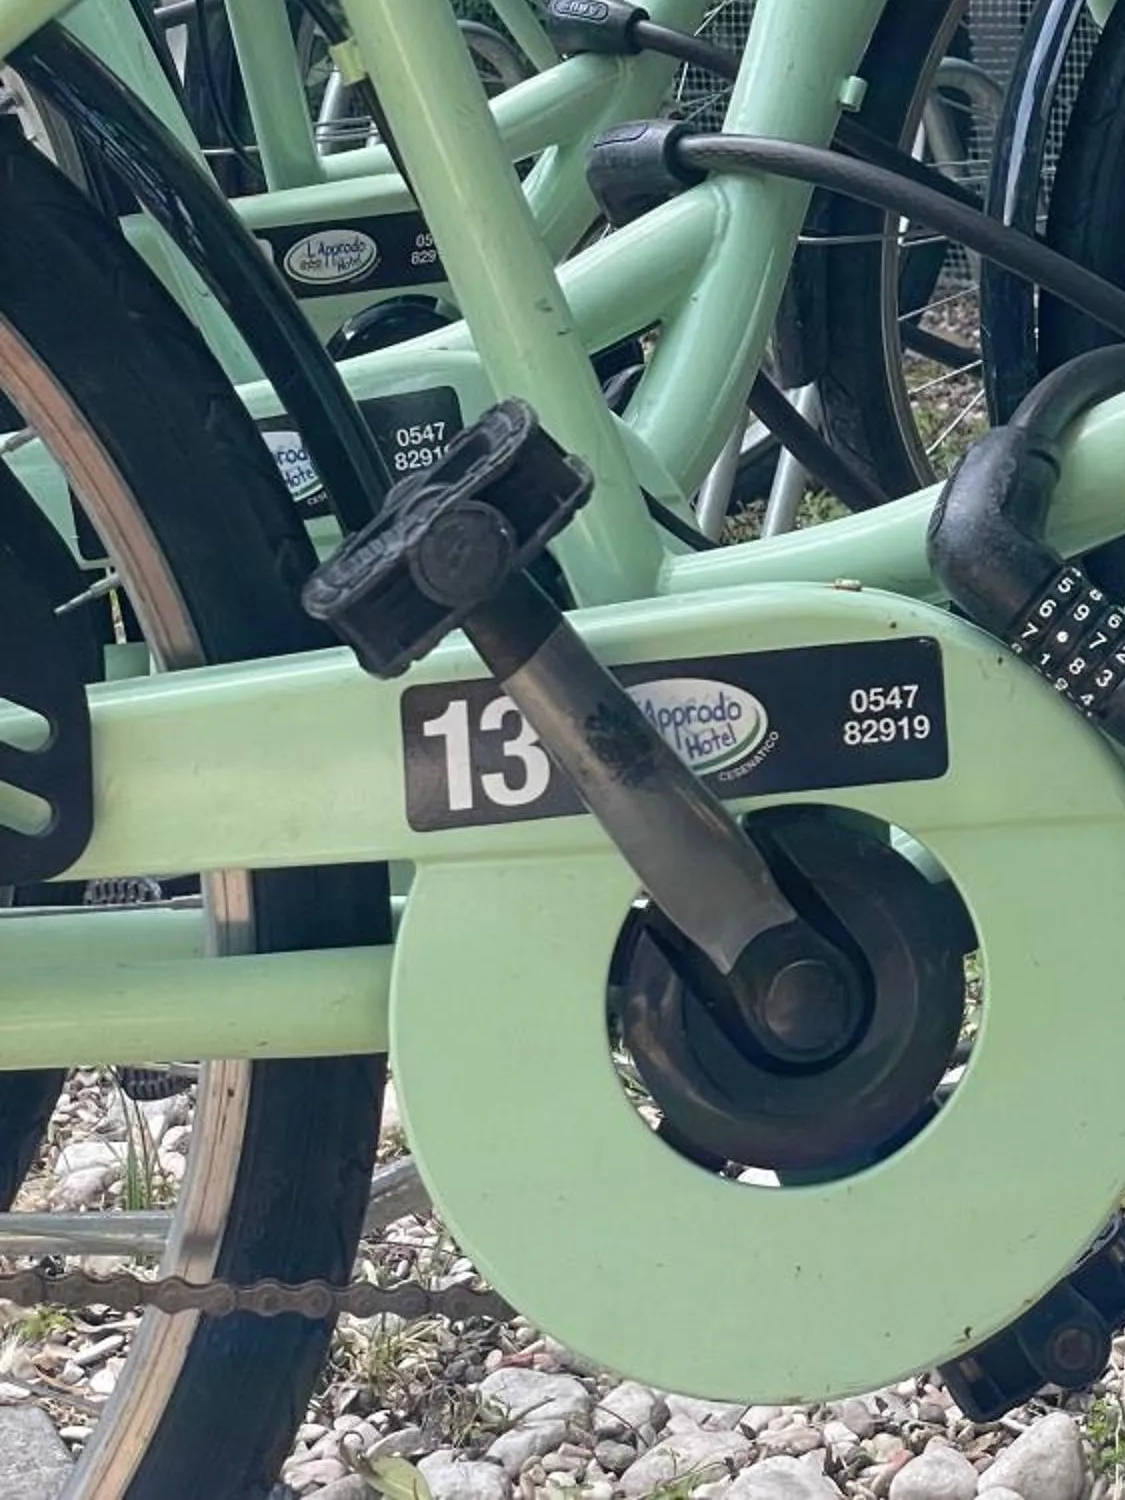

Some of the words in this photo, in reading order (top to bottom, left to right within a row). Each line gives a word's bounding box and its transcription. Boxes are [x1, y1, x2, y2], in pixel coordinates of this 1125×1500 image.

[415, 233, 433, 248] 05
[397, 421, 445, 447] 0547
[394, 444, 450, 471] 8291
[1057, 577, 1075, 593] 5
[1039, 599, 1057, 618] 6
[1073, 603, 1090, 621] 9
[1020, 622, 1039, 639] 7
[1088, 631, 1108, 649] 7
[1068, 657, 1087, 675] 8
[1095, 669, 1113, 688] 3
[850, 684, 919, 714] 0547
[843, 714, 931, 746] 82919
[685, 722, 738, 760] Hotel
[423, 695, 550, 810] 13
[718, 731, 780, 782] CESENATICO
